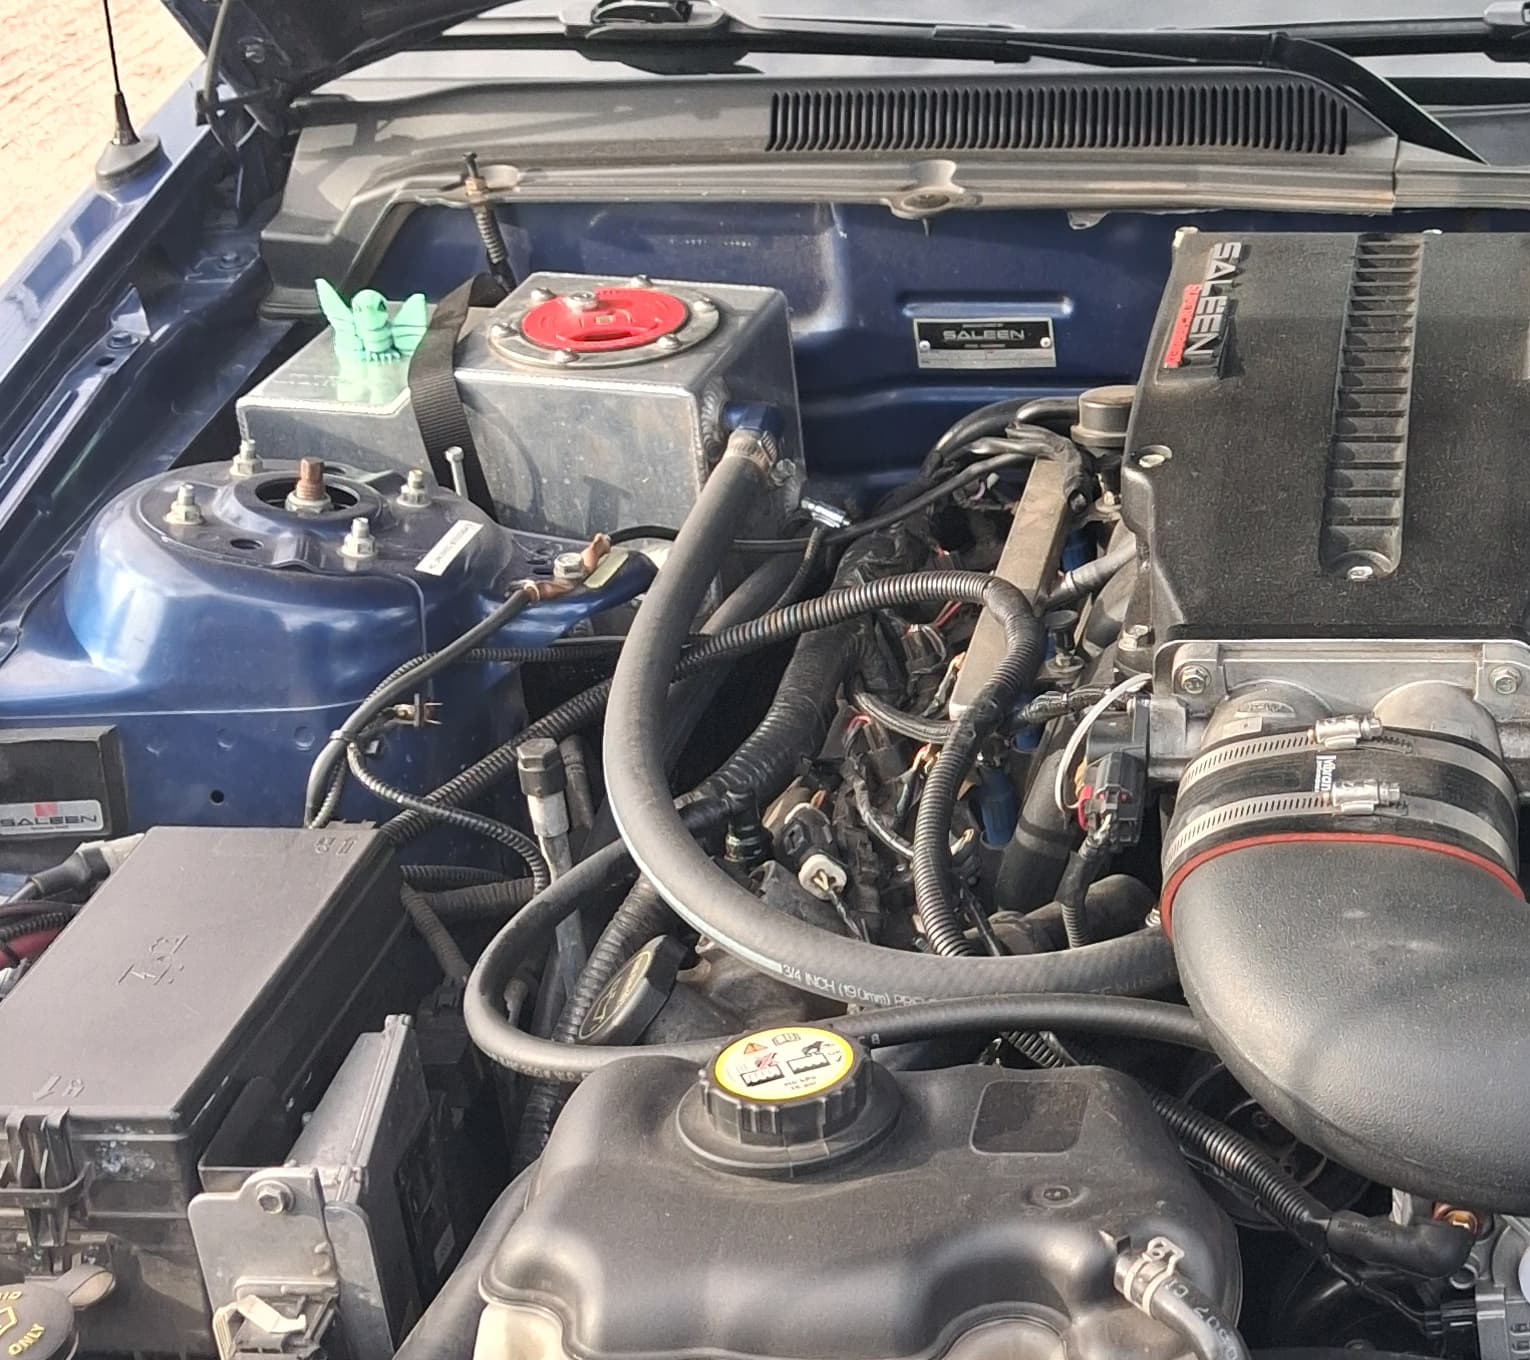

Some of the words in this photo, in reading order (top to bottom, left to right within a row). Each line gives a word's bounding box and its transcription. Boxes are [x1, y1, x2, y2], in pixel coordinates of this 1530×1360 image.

[1184, 242, 1241, 357] SALEEN
[942, 329, 1025, 341] SALEEN
[0, 814, 97, 827] SALEEN
[783, 965, 801, 981] 3/4
[805, 972, 835, 993] INCH
[8, 1322, 45, 1355] ONLY
